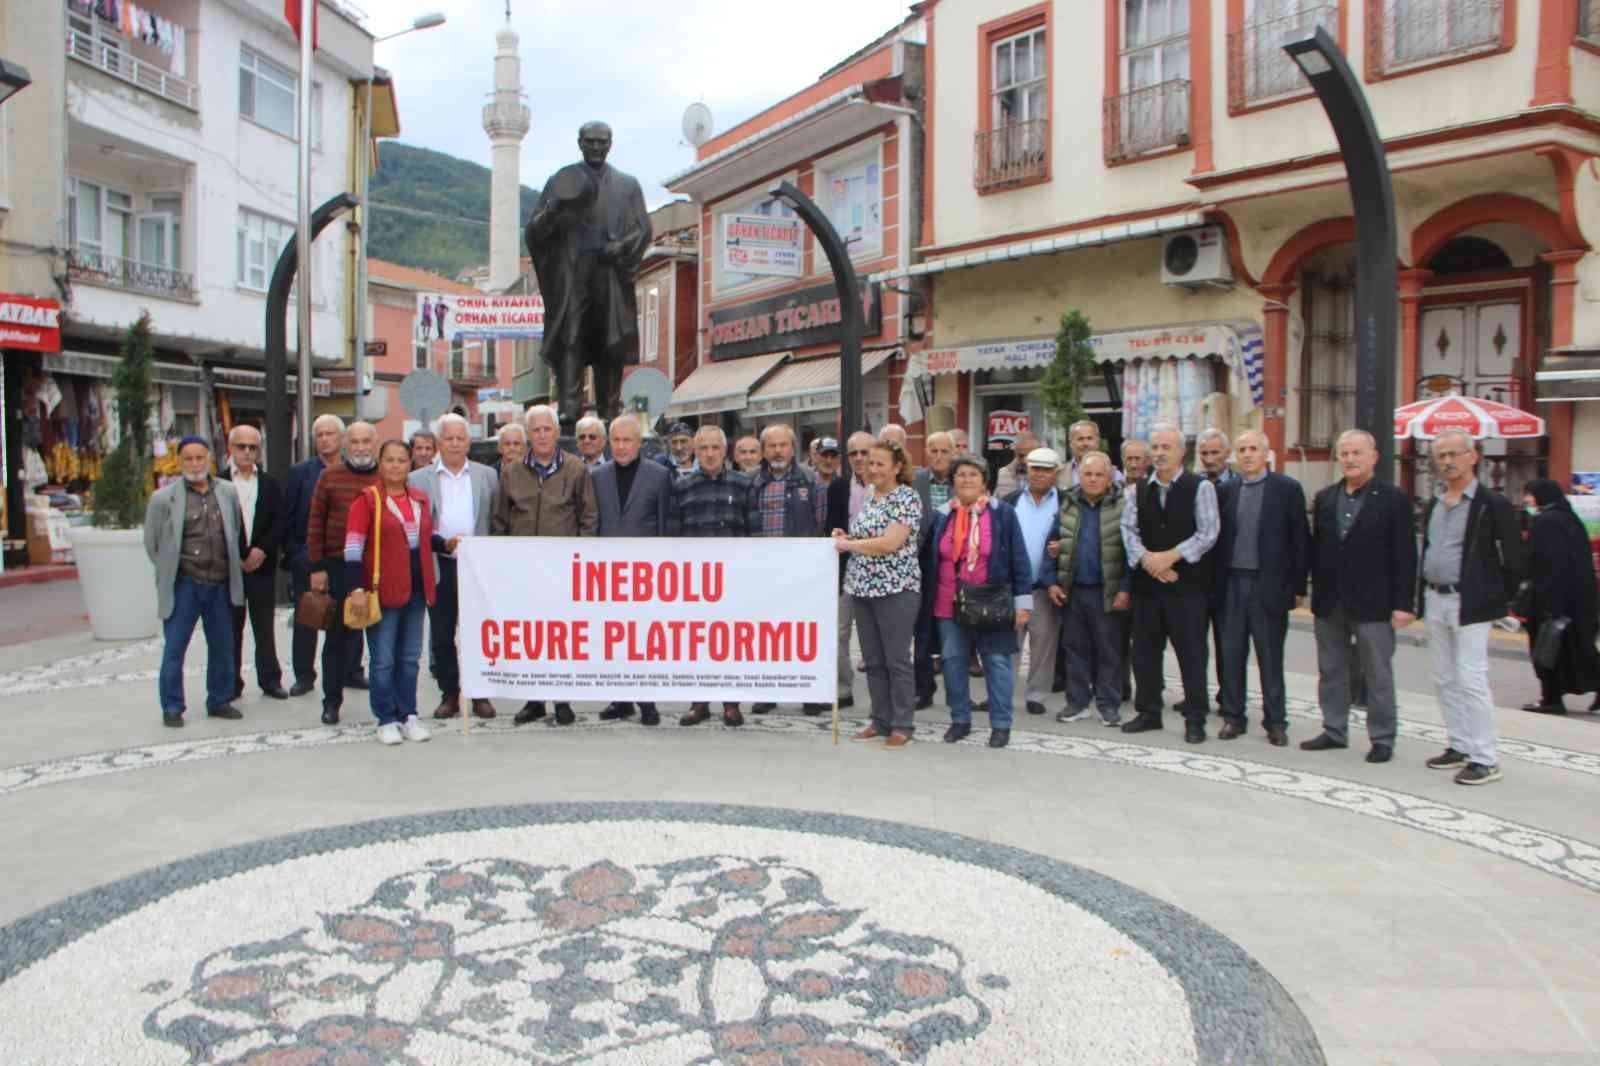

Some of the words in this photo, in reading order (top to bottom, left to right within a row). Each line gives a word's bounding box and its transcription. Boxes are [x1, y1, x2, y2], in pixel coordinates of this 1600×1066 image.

[492, 295, 545, 308] KIYAFETL
[455, 312, 497, 325] ORHAN
[713, 313, 771, 346] ORHAN
[571, 552, 724, 602] İNEBOLU
[480, 618, 589, 666] ÇEVRE
[603, 621, 818, 662] PLATFORMU
